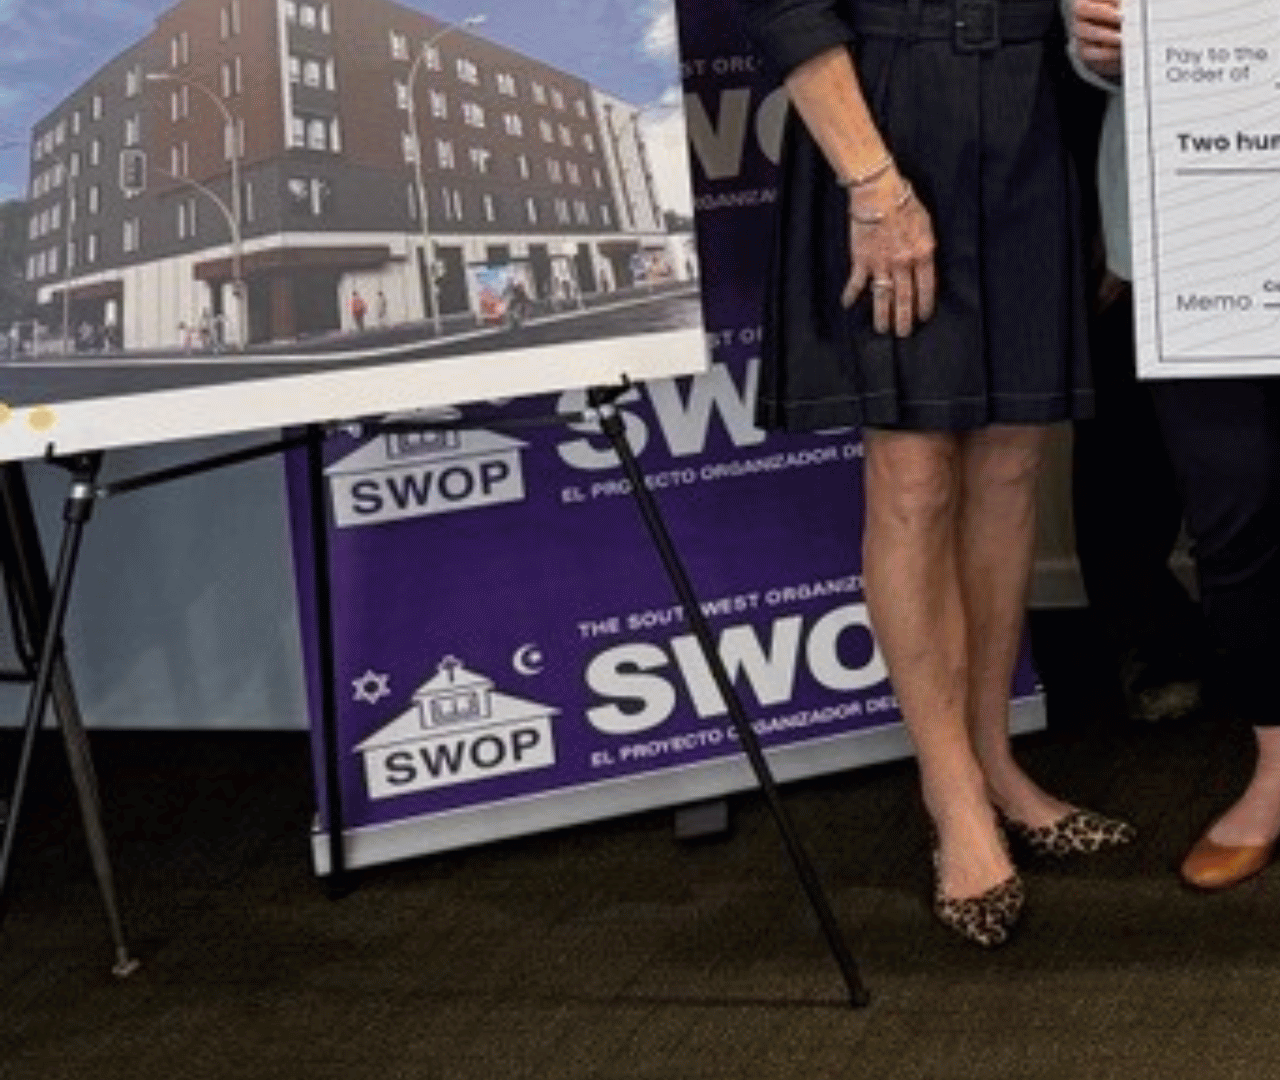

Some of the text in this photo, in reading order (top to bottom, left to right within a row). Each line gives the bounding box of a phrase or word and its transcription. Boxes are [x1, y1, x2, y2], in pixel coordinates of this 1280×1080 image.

[1165, 46, 1268, 65] Pay to the
[1165, 65, 1251, 84] Order of
[1177, 131, 1230, 153] Two
[1177, 293, 1252, 312] Memo
[556, 358, 768, 470] SW
[351, 460, 510, 516] SWOP
[561, 486, 587, 504] EL
[592, 467, 697, 499] PROECTO
[701, 444, 839, 482] ORGANIZADOR
[577, 575, 865, 639] THE SOUTWEST ORGANIZ
[585, 601, 891, 736] SWO
[384, 728, 541, 787] SWOP
[591, 751, 615, 768] EL
[620, 727, 729, 760] PROYECTO
